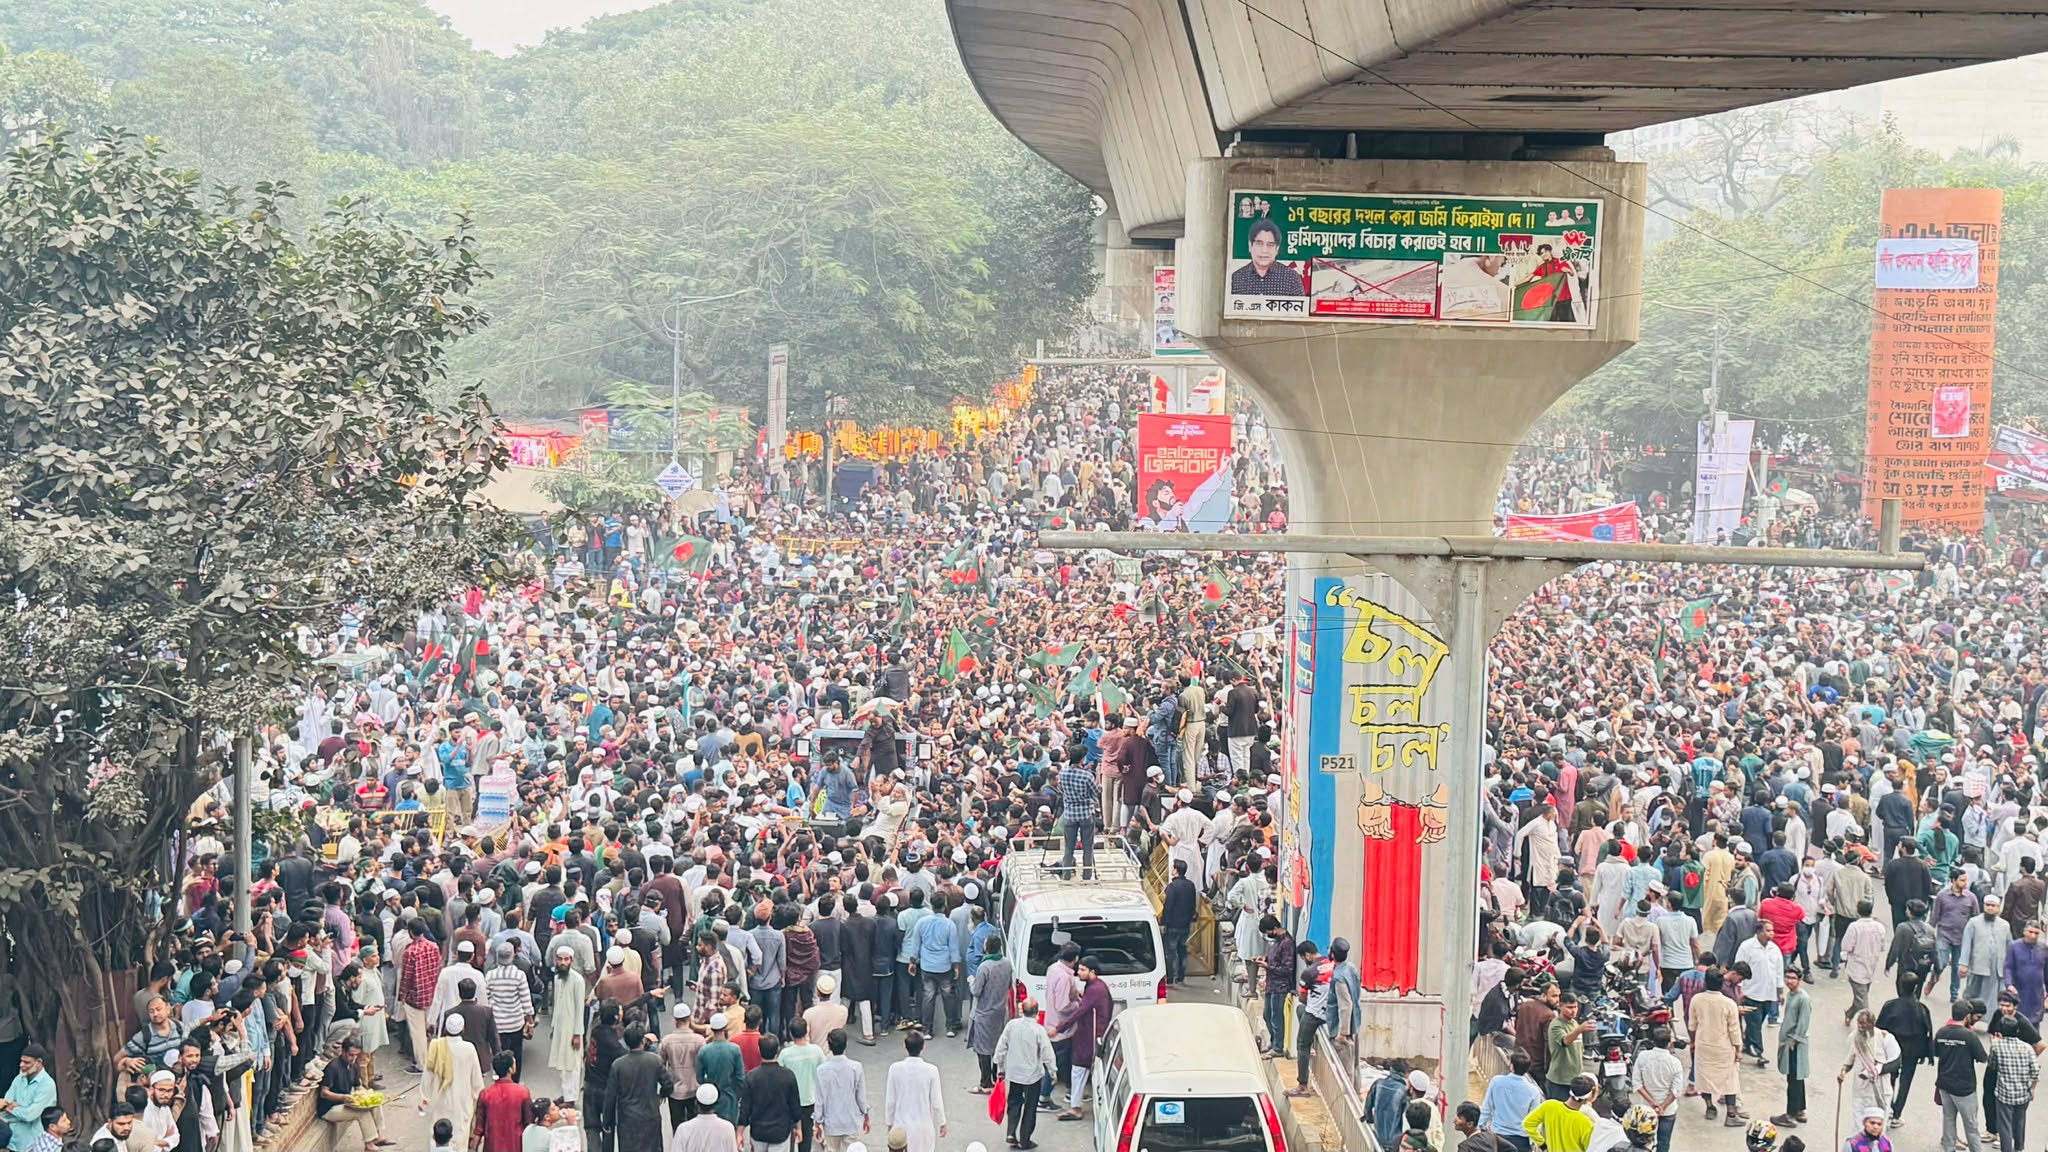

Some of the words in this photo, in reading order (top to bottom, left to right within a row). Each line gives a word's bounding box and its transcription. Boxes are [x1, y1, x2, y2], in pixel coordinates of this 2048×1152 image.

[1288, 207, 1305, 222] ১৭
[1309, 207, 1351, 225] বছরের
[1355, 208, 1385, 224] দখল
[1389, 209, 1416, 226] করা
[1419, 205, 1448, 227] জমি
[1451, 206, 1504, 230] ফিরাইয়া
[1507, 213, 1522, 229] দে
[1287, 226, 1357, 255] ভূমিদস্যুদের
[1360, 228, 1397, 251] বিচার
[1400, 230, 1447, 252] করতেই
[1450, 235, 1472, 251] হবে
[1265, 299, 1304, 312] কাকন
[1944, 298, 1976, 308] অথবা
[1891, 351, 1909, 365] খুনি
[1912, 351, 1958, 365] হাসিনার
[1938, 369, 1973, 379] রাখবো
[1888, 427, 1928, 438] আমরা
[1896, 440, 1923, 451] তোর
[1929, 441, 1952, 451] বাপ
[1157, 446, 1218, 459] ইনকিলাব
[1144, 454, 1218, 473] জিন্দাবাদ
[1348, 684, 1426, 726] চল
[1321, 756, 1355, 770] P521
[1130, 979, 1152, 988] নির্বাচন
